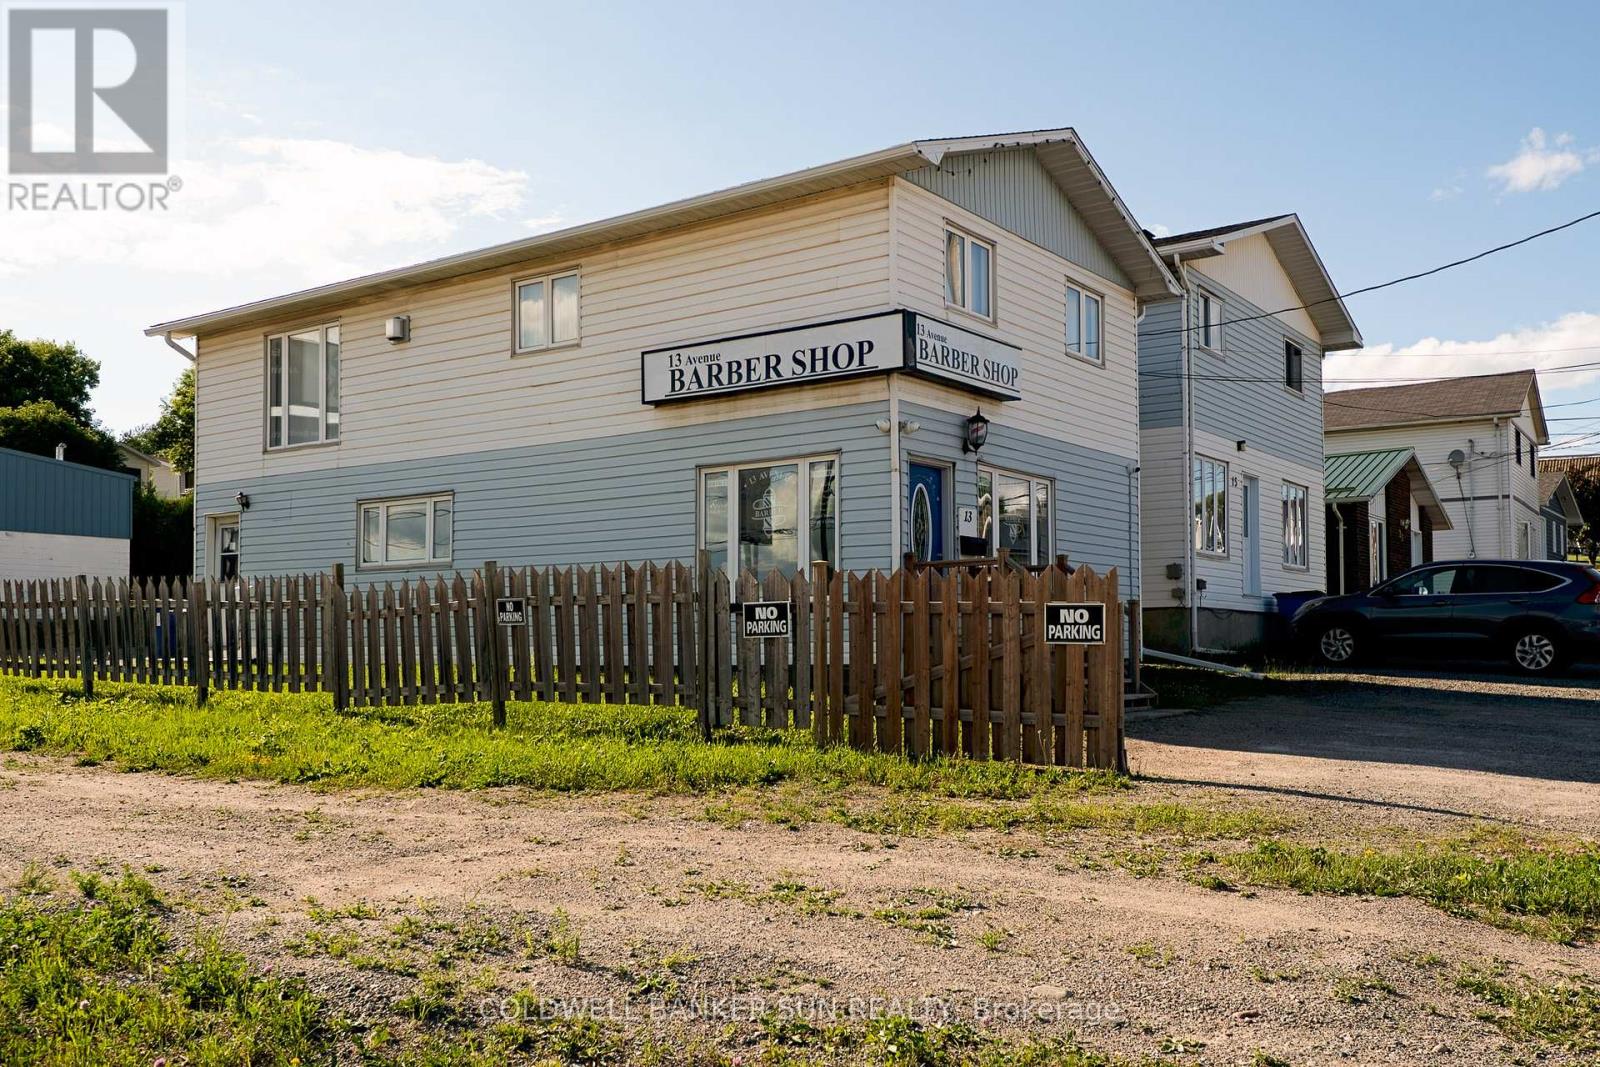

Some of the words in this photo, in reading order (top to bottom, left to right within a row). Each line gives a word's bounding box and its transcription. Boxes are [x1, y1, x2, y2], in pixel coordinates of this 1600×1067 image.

[916, 323, 925, 336] 13
[927, 329, 947, 343] Avenue
[668, 353, 682, 368] 13
[685, 352, 721, 366] Avenue
[669, 354, 785, 393] BARBER
[791, 340, 874, 376] SHOP
[919, 338, 980, 376] BARBER
[983, 358, 1018, 387] SHOP
[964, 510, 973, 523] 13
[505, 601, 514, 611] NO
[755, 606, 778, 620] NO
[499, 611, 523, 622] PARKING
[1059, 608, 1089, 624] NO
[746, 620, 787, 634] PARKING
[1048, 624, 1101, 640] PARKING
